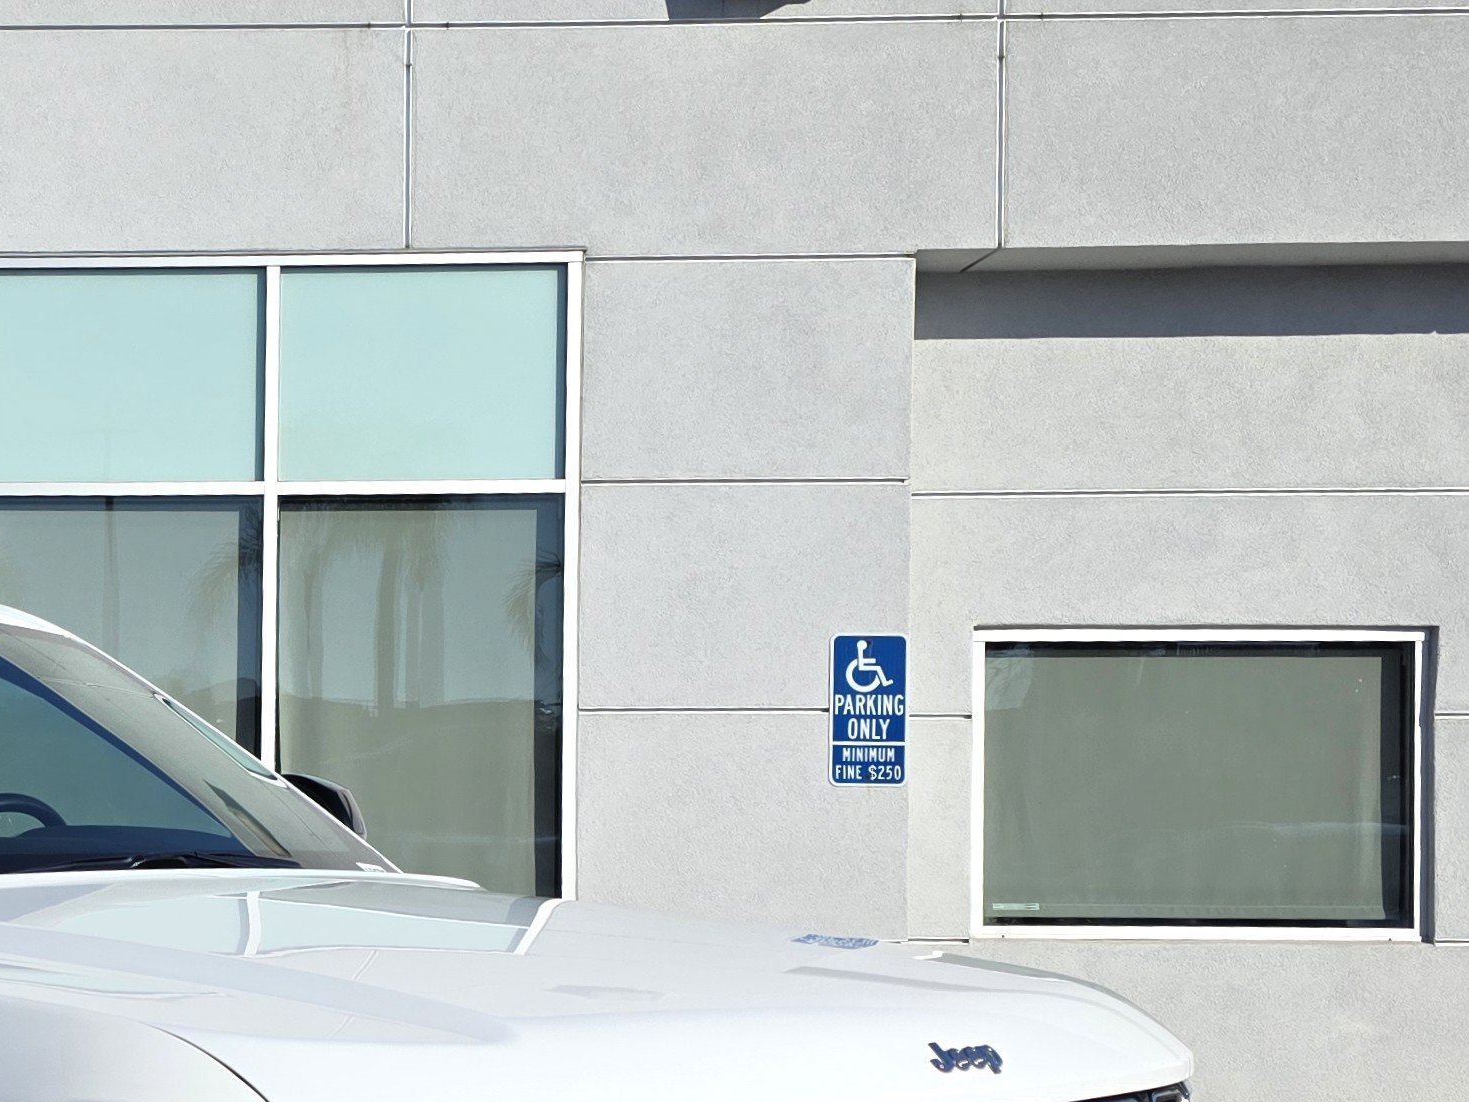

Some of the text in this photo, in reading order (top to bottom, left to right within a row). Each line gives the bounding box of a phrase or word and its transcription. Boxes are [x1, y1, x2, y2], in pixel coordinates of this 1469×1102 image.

[834, 694, 905, 716] PARKING
[847, 718, 891, 740] ONLY
[842, 747, 896, 762] MINIMUM
[835, 764, 902, 781] FINE $250
[927, 1042, 1004, 1075] Jeep
